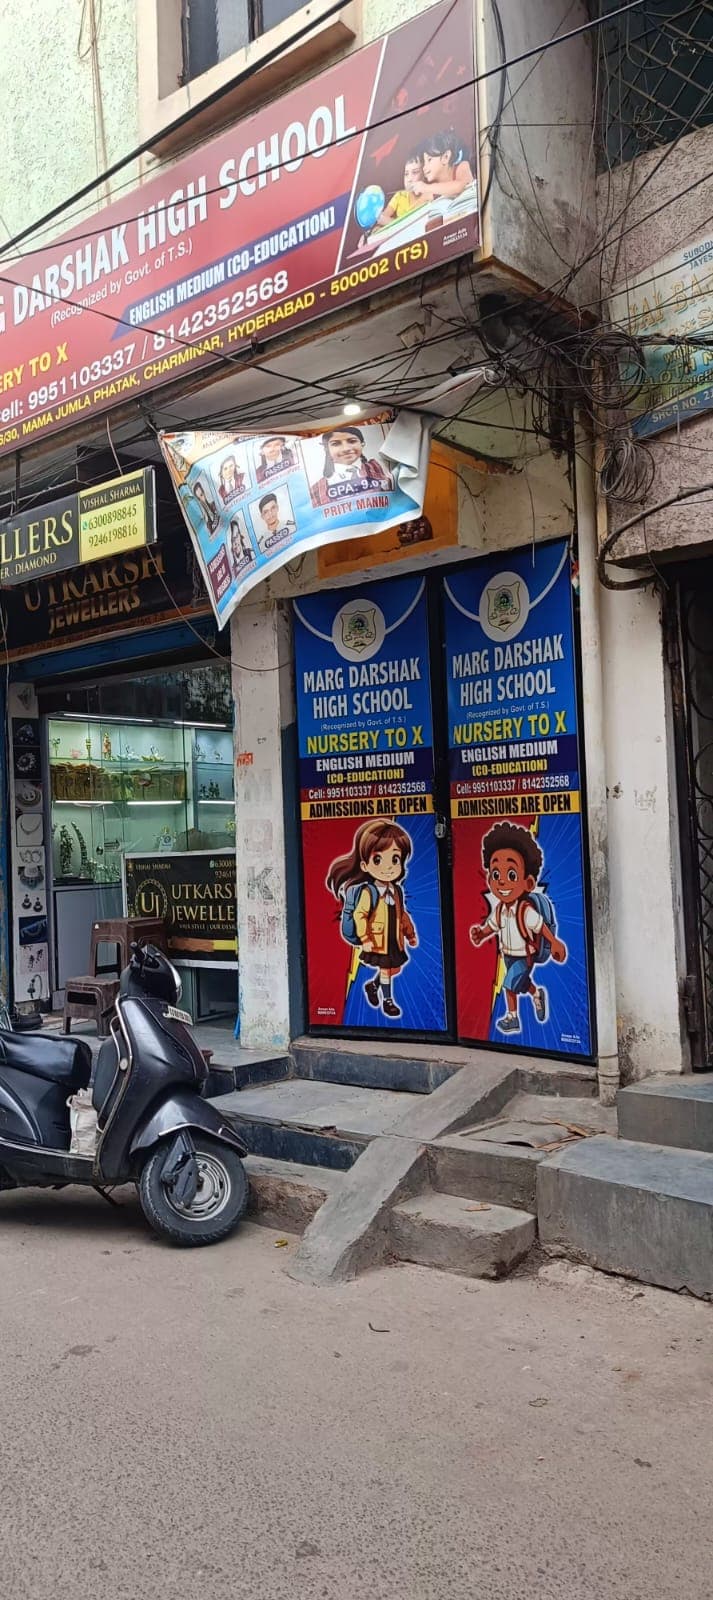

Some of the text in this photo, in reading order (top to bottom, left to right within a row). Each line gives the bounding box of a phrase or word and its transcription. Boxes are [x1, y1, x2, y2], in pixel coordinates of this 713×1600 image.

[13, 94, 357, 325] DARSHAK HIGH SCHOOL
[51, 238, 193, 328] (Recognized by Govt. of T.S.)
[129, 288, 174, 325] ENGLISH
[176, 265, 225, 304] MEDIUM
[0, 399, 23, 423] ell:
[28, 343, 135, 410] 9951103337
[153, 270, 289, 351] 8142352568
[22, 414, 53, 435] MAMA
[55, 395, 91, 423] JUMLA
[93, 372, 140, 404] PHATAK,
[143, 335, 224, 380] CHARMINAR,
[228, 290, 315, 342] HYDERABAD
[330, 258, 389, 296] 500002
[394, 240, 429, 270] (TS)
[29, 352, 51, 377] TO
[56, 342, 69, 365] X
[110, 483, 141, 500] SHARMA
[327, 482, 358, 498] GPA:
[323, 495, 390, 518] PRITY MANNA
[15, 552, 57, 576] DIAMOND
[48, 585, 141, 635] JEWELLERS
[452, 633, 564, 679] MARG DARSHAK
[303, 657, 421, 693] MARG DARSHAK
[460, 668, 556, 707] HIGH SCHOOL
[313, 687, 413, 719] HIGH SCHOOL
[501, 707, 509, 715] by
[307, 725, 424, 754] NURSERY TO X
[358, 721, 366, 729] by
[453, 710, 567, 745] NURSERY TO X
[316, 751, 415, 772] ENGLISH MEDIUM
[461, 740, 558, 763] ENGLISH MEDIUM
[308, 789, 325, 799] Cell:
[327, 784, 372, 798] 9951103337
[378, 781, 426, 795] 8142352568
[456, 783, 472, 794] Cell:
[472, 779, 516, 793] 9951103337
[521, 775, 570, 789] 8142352568
[309, 796, 427, 818] ADMISSIONS ARE OPEN
[457, 794, 571, 817] ADMISSIONS ARE OPEN
